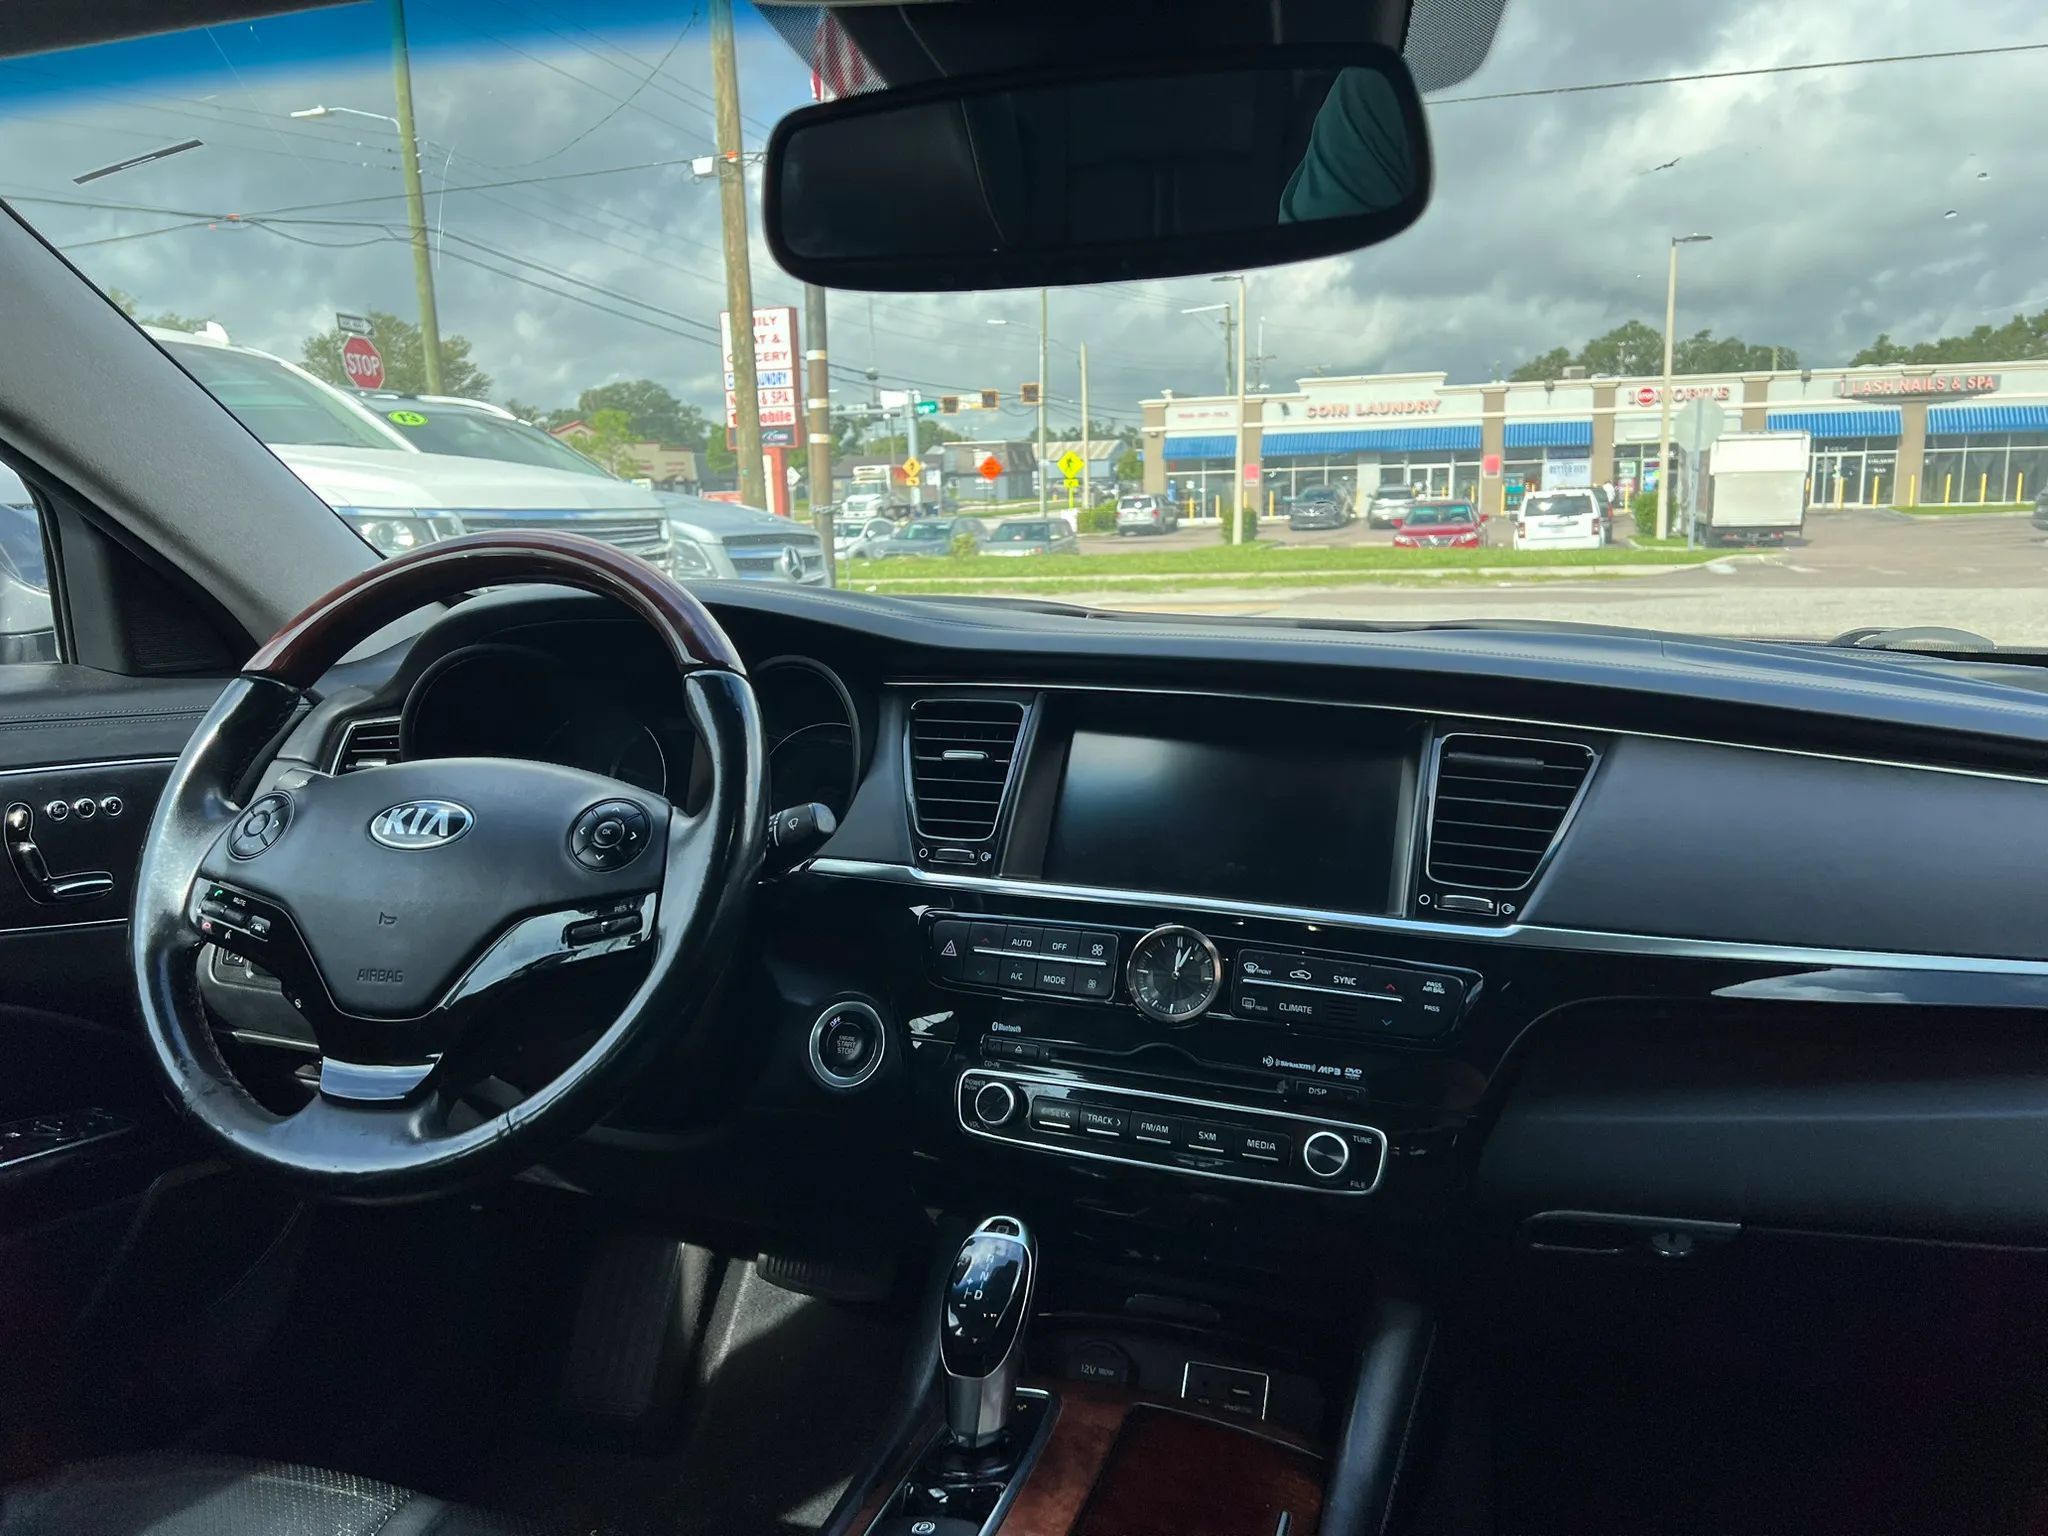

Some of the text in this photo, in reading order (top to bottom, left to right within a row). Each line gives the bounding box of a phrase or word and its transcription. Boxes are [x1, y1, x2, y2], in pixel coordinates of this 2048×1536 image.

[346, 352, 380, 376] STOP
[1852, 379, 1894, 394] LASH
[1899, 374, 1946, 392] NAILS
[1951, 374, 1961, 390] &
[1967, 374, 1995, 389] SPA
[1306, 400, 1441, 418] COIN LAUNDRY
[382, 807, 451, 837] KIA
[601, 828, 612, 836] OK
[614, 904, 628, 913] RES
[1011, 938, 1033, 948] AUTO
[1052, 942, 1067, 951] OFF
[357, 968, 405, 983] AIRBAG
[1010, 971, 1023, 982] A/C
[1043, 975, 1066, 985] MODE
[1333, 975, 1357, 986] SYNC
[1279, 1002, 1313, 1015] CLIMATE
[1424, 1004, 1441, 1013] PASS
[837, 1040, 856, 1048] START
[1317, 1066, 1342, 1076] MP3
[1344, 1067, 1363, 1076] DVD
[1308, 1087, 1328, 1096] DISP
[1087, 1114, 1113, 1126] TRACK
[1141, 1122, 1169, 1134] FM/AM
[1198, 1131, 1217, 1142] SXM
[1352, 1135, 1373, 1145] TUNE
[1247, 1138, 1276, 1151] MEDIA
[980, 1271, 990, 1282] N
[974, 1289, 984, 1300] D
[1081, 1364, 1097, 1376] 12V
